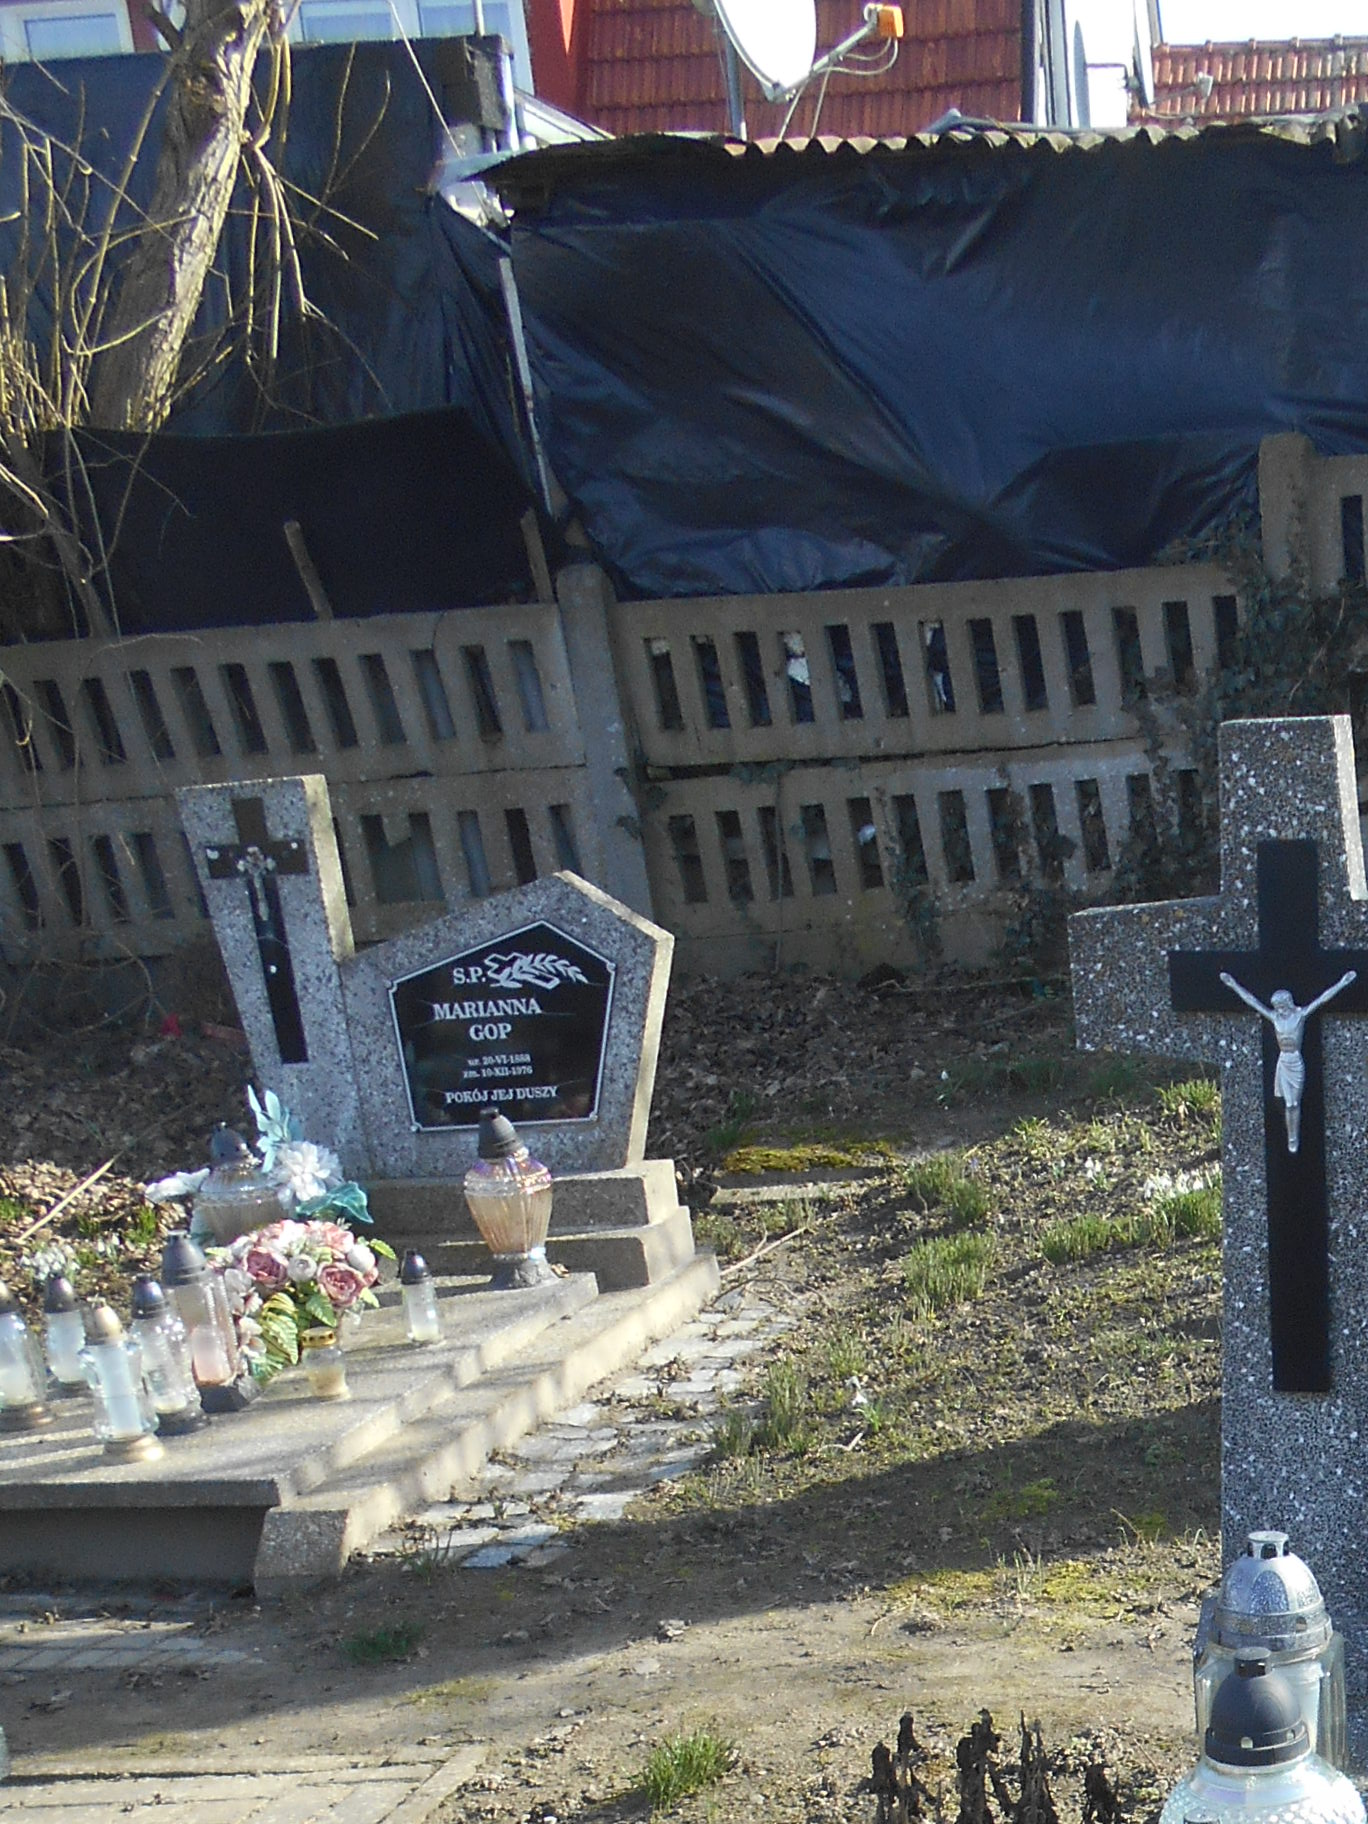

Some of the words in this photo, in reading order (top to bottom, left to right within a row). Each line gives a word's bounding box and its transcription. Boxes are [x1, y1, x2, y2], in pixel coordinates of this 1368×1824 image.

[432, 997, 543, 1021] MARIANNA
[468, 1022, 512, 1041] GOP
[445, 1087, 489, 1104] POKÓJ
[490, 1087, 514, 1101] JEJ
[515, 1085, 558, 1100] DUSZY
